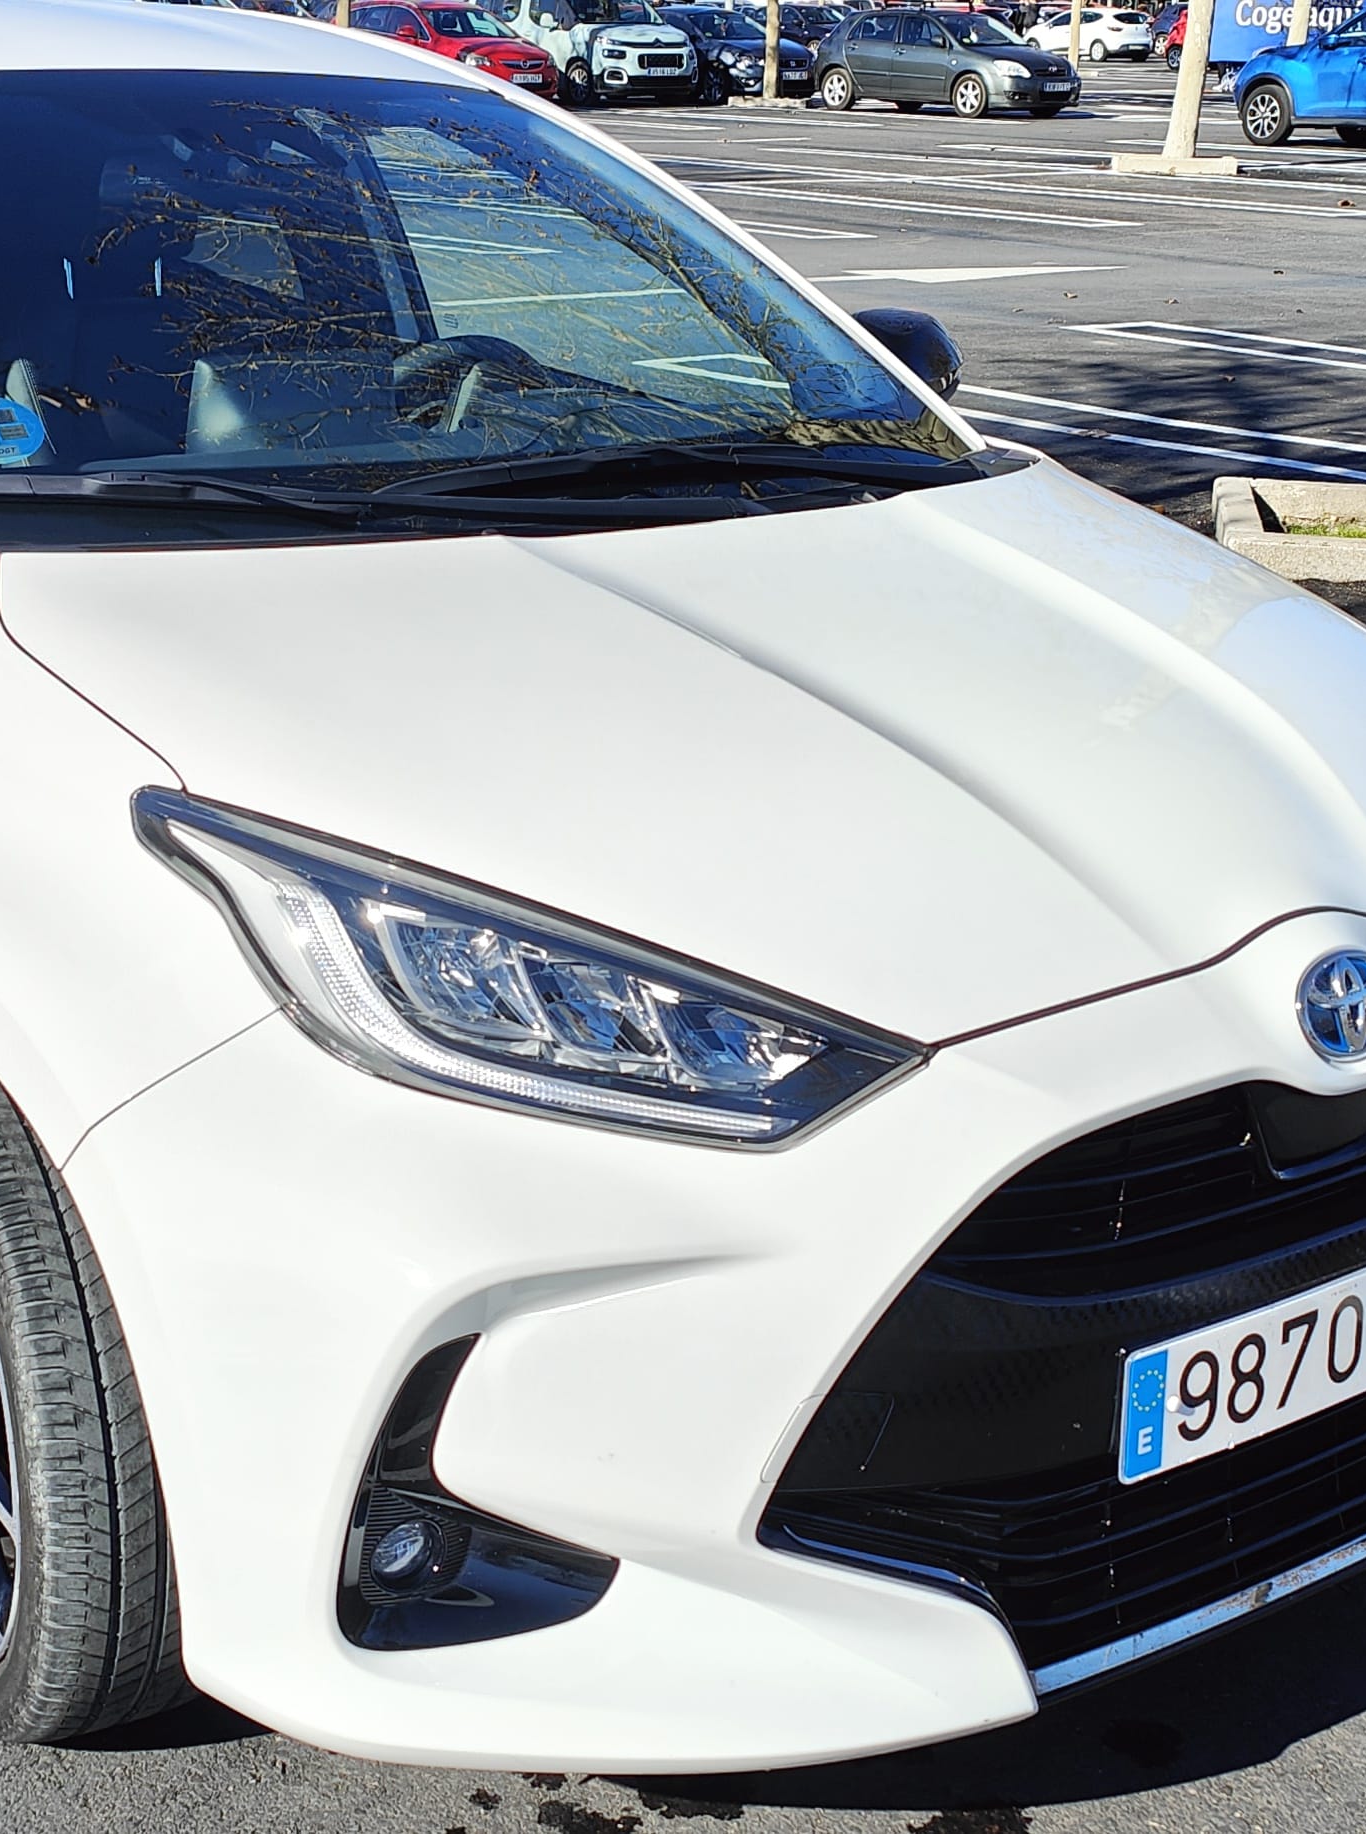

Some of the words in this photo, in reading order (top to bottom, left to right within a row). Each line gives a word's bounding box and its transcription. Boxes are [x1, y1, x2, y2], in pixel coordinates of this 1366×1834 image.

[1235, 0, 1294, 34] Coge
[1138, 1426, 1153, 1455] E
[1177, 1294, 1364, 1442] 9870
